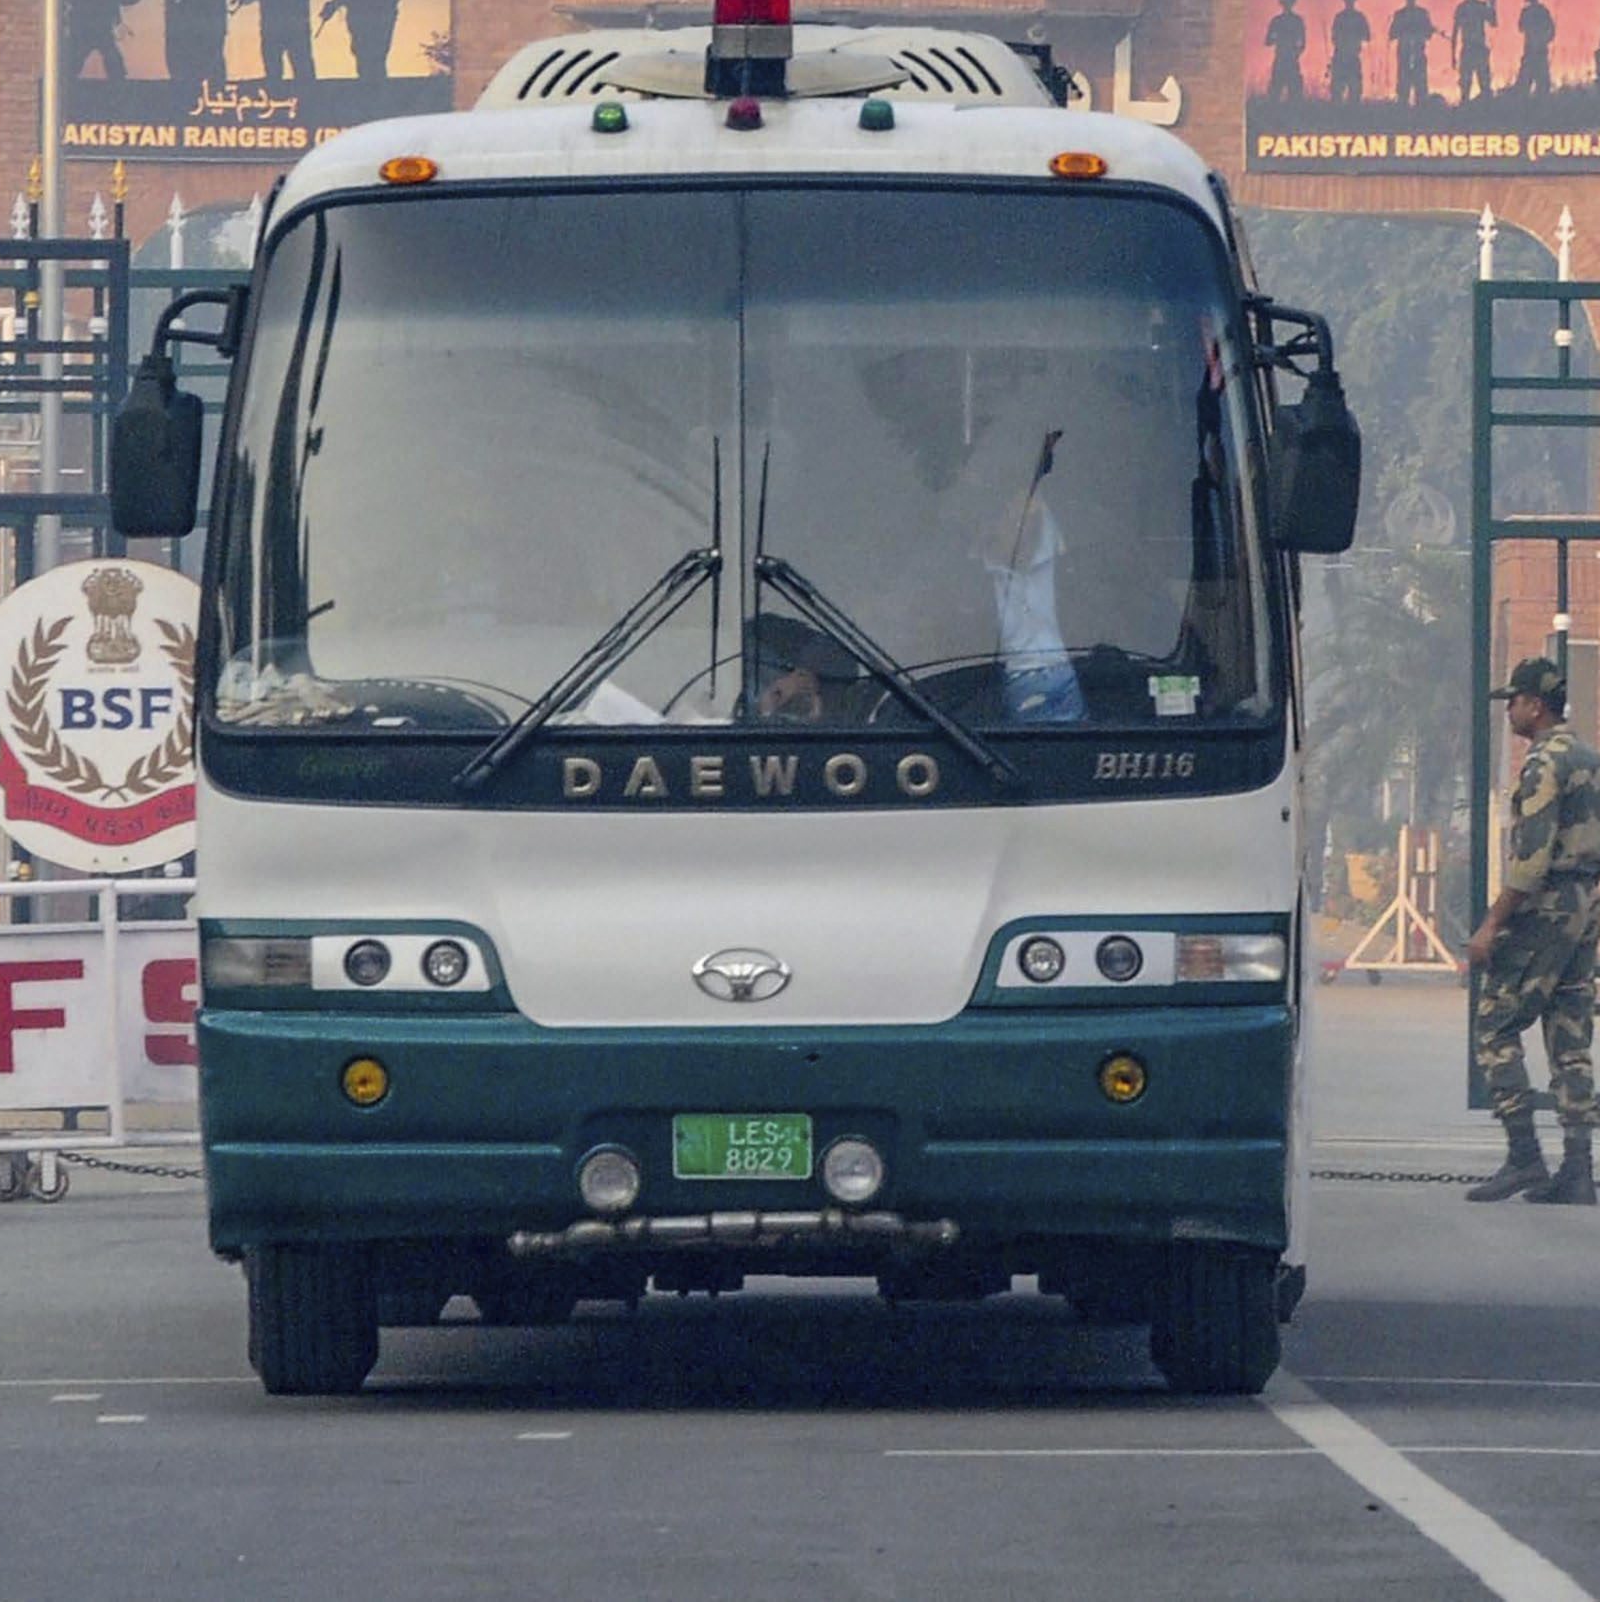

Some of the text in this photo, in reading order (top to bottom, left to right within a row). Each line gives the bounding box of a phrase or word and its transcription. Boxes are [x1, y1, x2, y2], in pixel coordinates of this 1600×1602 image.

[63, 124, 176, 147] AKISTAN
[184, 126, 307, 149] RANGERS
[1257, 134, 1388, 159] PAKISTAN
[1395, 134, 1520, 159] RANGERS
[58, 688, 174, 730] BSF
[563, 752, 1196, 797] DAEWOO BH116
[726, 1147, 793, 1172] 8829
